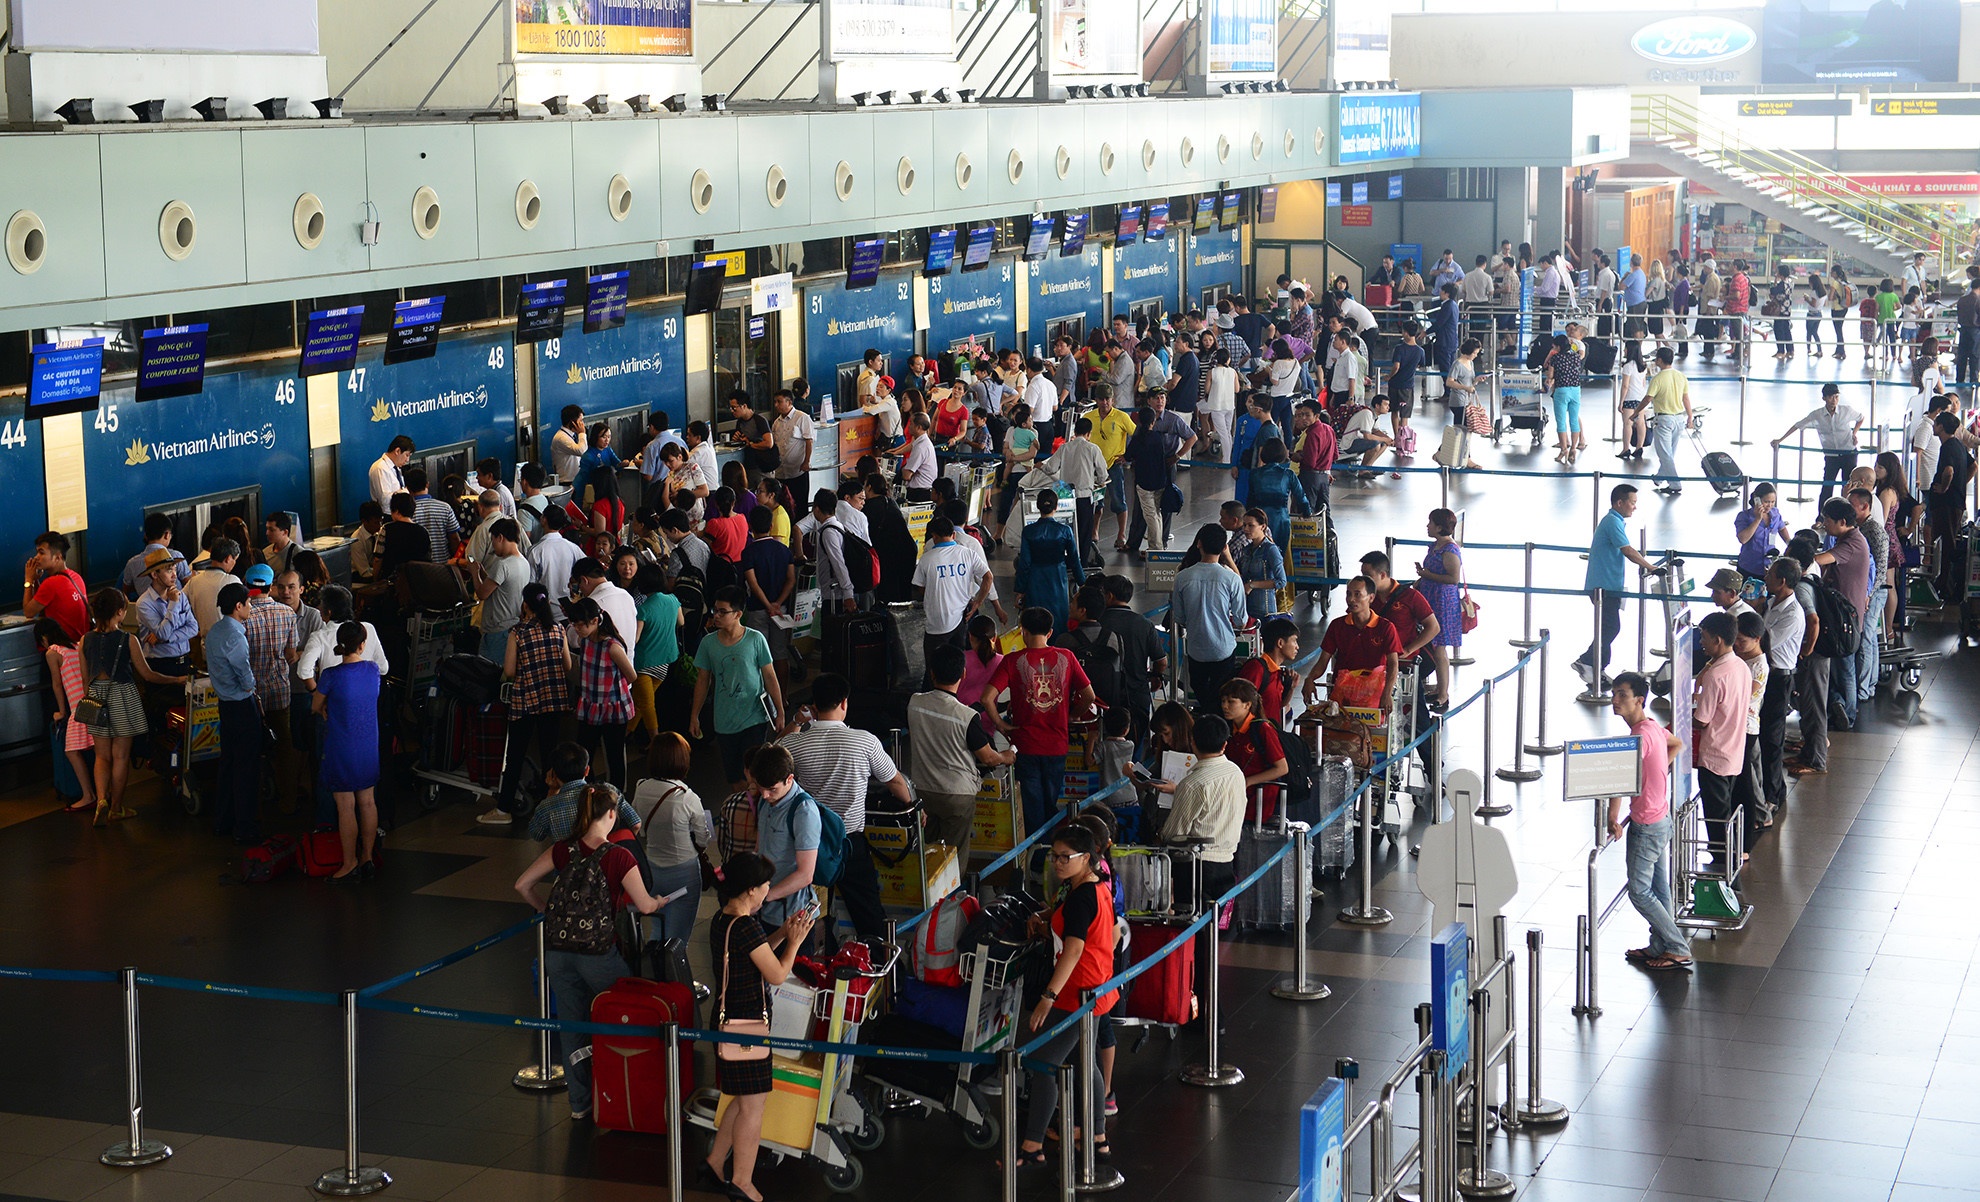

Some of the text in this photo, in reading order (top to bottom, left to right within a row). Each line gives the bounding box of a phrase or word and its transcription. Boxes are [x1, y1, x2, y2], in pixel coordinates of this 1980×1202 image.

[555, 30, 580, 48] 1800
[584, 30, 606, 48] 1086
[1656, 28, 1731, 55] Ford
[1914, 184, 1922, 192] &
[1926, 183, 1978, 192] SOUVENIR
[1168, 238, 1175, 253] 58
[1091, 252, 1099, 267] 56
[1116, 248, 1123, 262] 57
[1200, 252, 1230, 266] Vietnam Airlines
[1002, 265, 1011, 282] 54
[1031, 260, 1040, 277] 55
[1130, 263, 1164, 278] Vietnam Airlines
[898, 282, 908, 300] 52
[932, 276, 942, 294] 53
[1049, 278, 1085, 295] Vietnam Airlines
[812, 295, 823, 314] 51
[953, 294, 996, 312] Vietnam Airlines
[327, 308, 348, 317] SAMSUNG
[164, 326, 188, 335] SAMSUNG
[663, 318, 676, 339] 50
[839, 314, 889, 334] Vietnam Airlines
[334, 334, 354, 342] CLOSED
[545, 337, 560, 359] 49
[147, 354, 200, 366] POSITION CLOSED
[488, 346, 504, 369] 48
[146, 369, 177, 379] COMPTOIR
[582, 357, 651, 381] Vietnam Airlines
[348, 368, 366, 393] 47
[42, 385, 92, 398] Domestic Flights
[275, 379, 295, 405] 46
[391, 390, 474, 417] Vietnam Airlines
[95, 405, 118, 433] 45
[1, 419, 26, 449] 44
[152, 428, 258, 460] Vietnam Airlines
[937, 563, 966, 578] TIC
[869, 832, 902, 842] BANK
